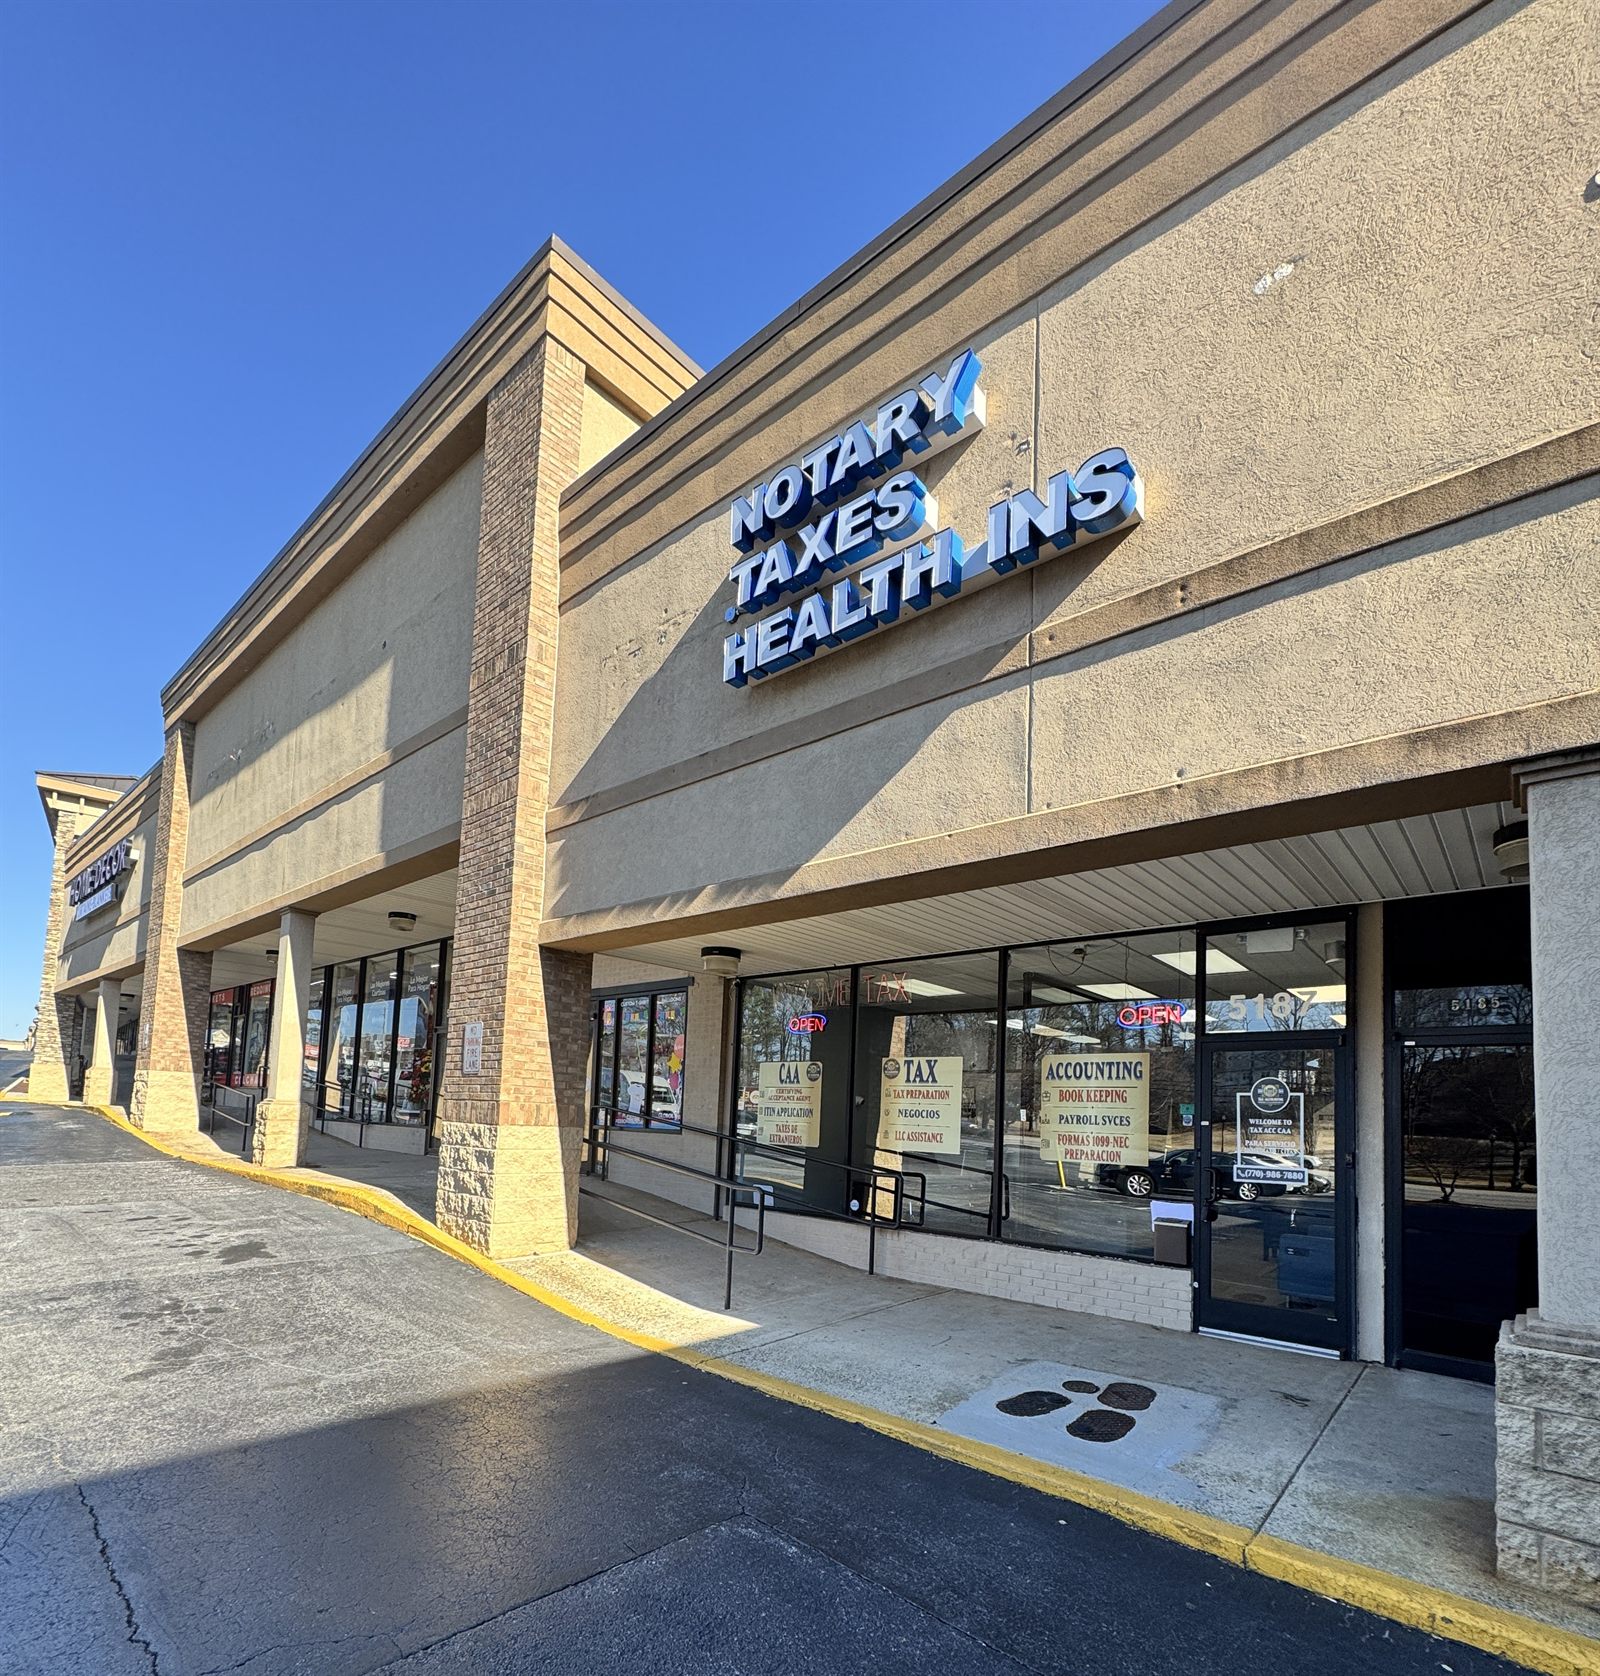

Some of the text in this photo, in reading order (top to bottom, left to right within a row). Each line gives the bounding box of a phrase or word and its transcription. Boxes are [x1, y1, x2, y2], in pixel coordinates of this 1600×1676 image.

[731, 347, 980, 551] NOTARY
[730, 471, 924, 610] TAXES
[724, 447, 1136, 687] HEALTH INS
[94, 839, 130, 889] DECOR
[863, 972, 908, 1003] TAX
[1228, 991, 1317, 1020] 5187
[1451, 997, 1500, 1011] 5185
[1120, 1004, 1181, 1025] OPEN
[789, 1017, 825, 1032] OPEN
[466, 1048, 478, 1058] FIRE
[465, 1059, 478, 1070] LANE
[904, 1059, 938, 1084] TAX
[1045, 1061, 1143, 1081] ACCOUNTING
[779, 1063, 800, 1084] CAA
[893, 1089, 950, 1100] TAX PREPARATION
[1058, 1089, 1127, 1103] BOOK KEEPING
[763, 1106, 814, 1118] ITIN APPLICATION
[897, 1108, 940, 1119] NEGOCIOS
[1058, 1113, 1131, 1127] PAYROLL SVCES
[1249, 1118, 1282, 1126] WELCOME
[776, 1123, 798, 1134] TAXES DE
[1277, 1127, 1292, 1135] CAA
[769, 1133, 802, 1145] EXTRANJEROS
[895, 1130, 944, 1144] LLC ASSISTANCE
[1057, 1133, 1130, 1149] FORMAS 1099-NEC
[1245, 1139, 1296, 1149] PARA SERVICIO
[1064, 1148, 1122, 1162] PREPARACION
